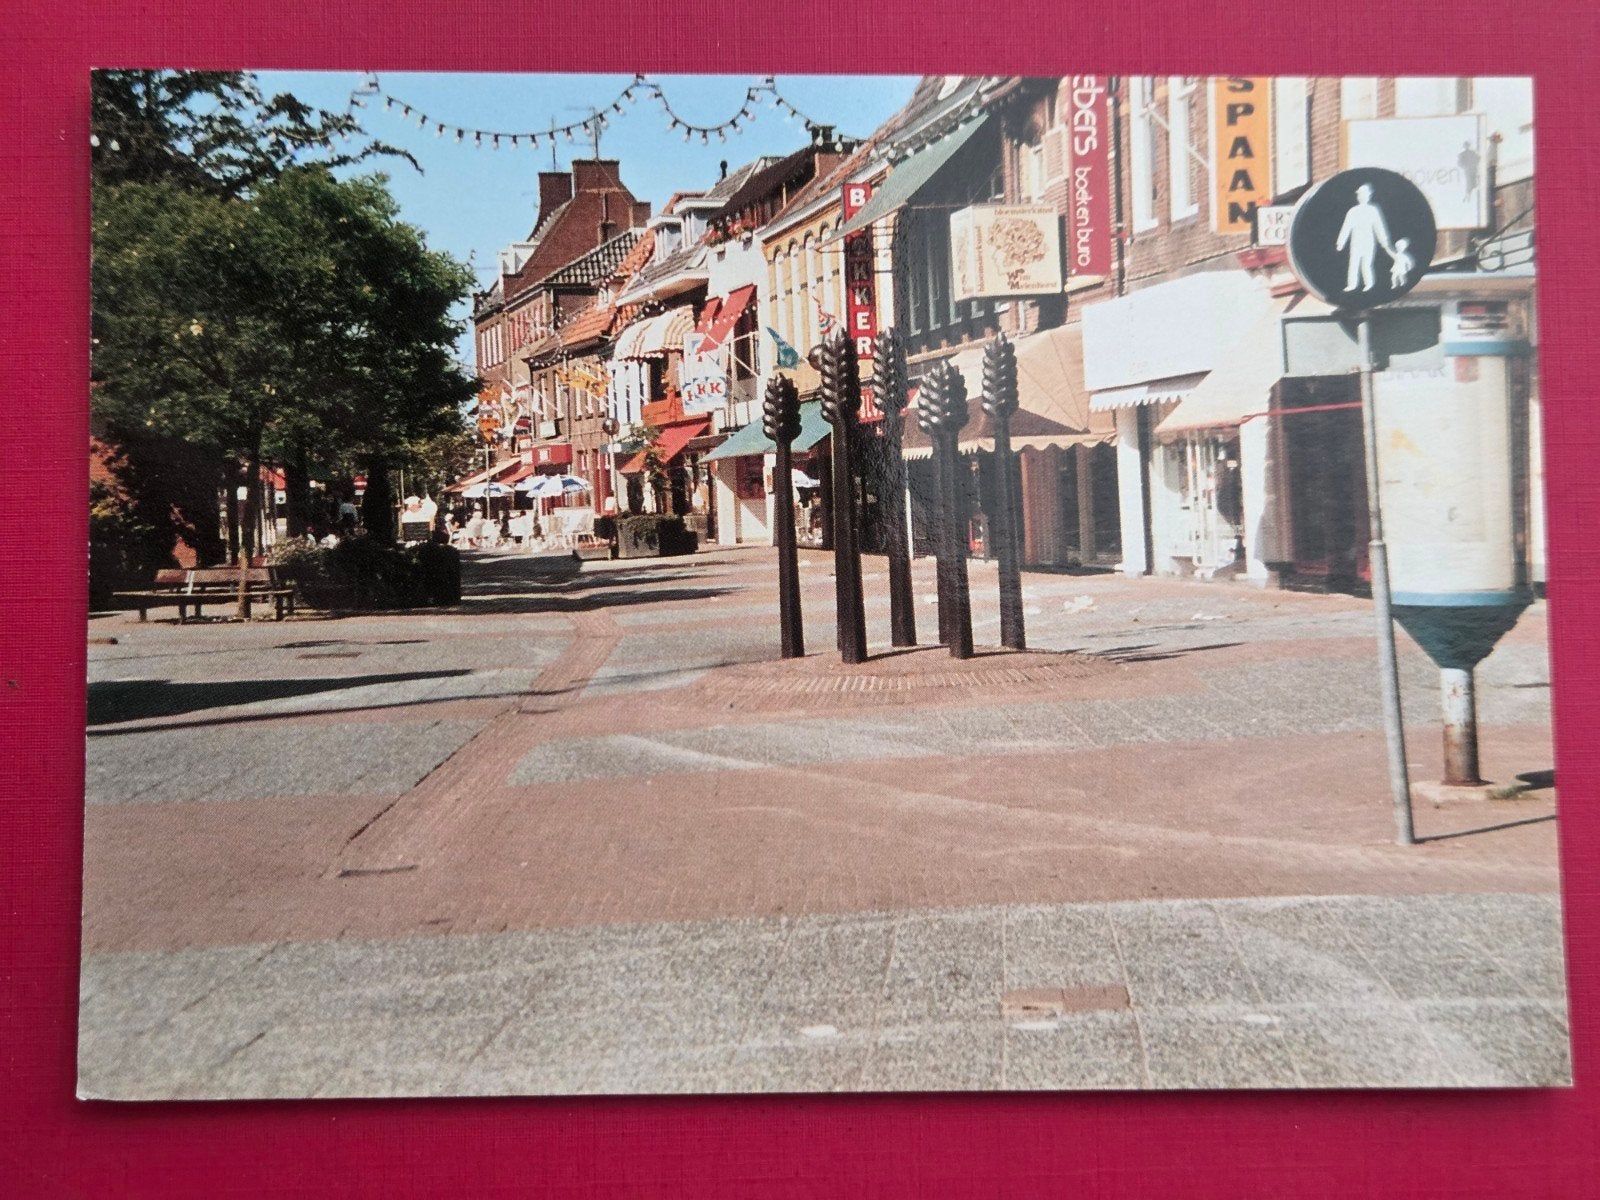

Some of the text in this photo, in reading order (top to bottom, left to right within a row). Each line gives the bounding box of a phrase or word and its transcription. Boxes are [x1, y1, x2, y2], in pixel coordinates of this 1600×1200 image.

[1226, 76, 1256, 224] SPAAN
[1075, 166, 1092, 206] boek
[1076, 206, 1089, 227] en
[1077, 228, 1093, 267] buro
